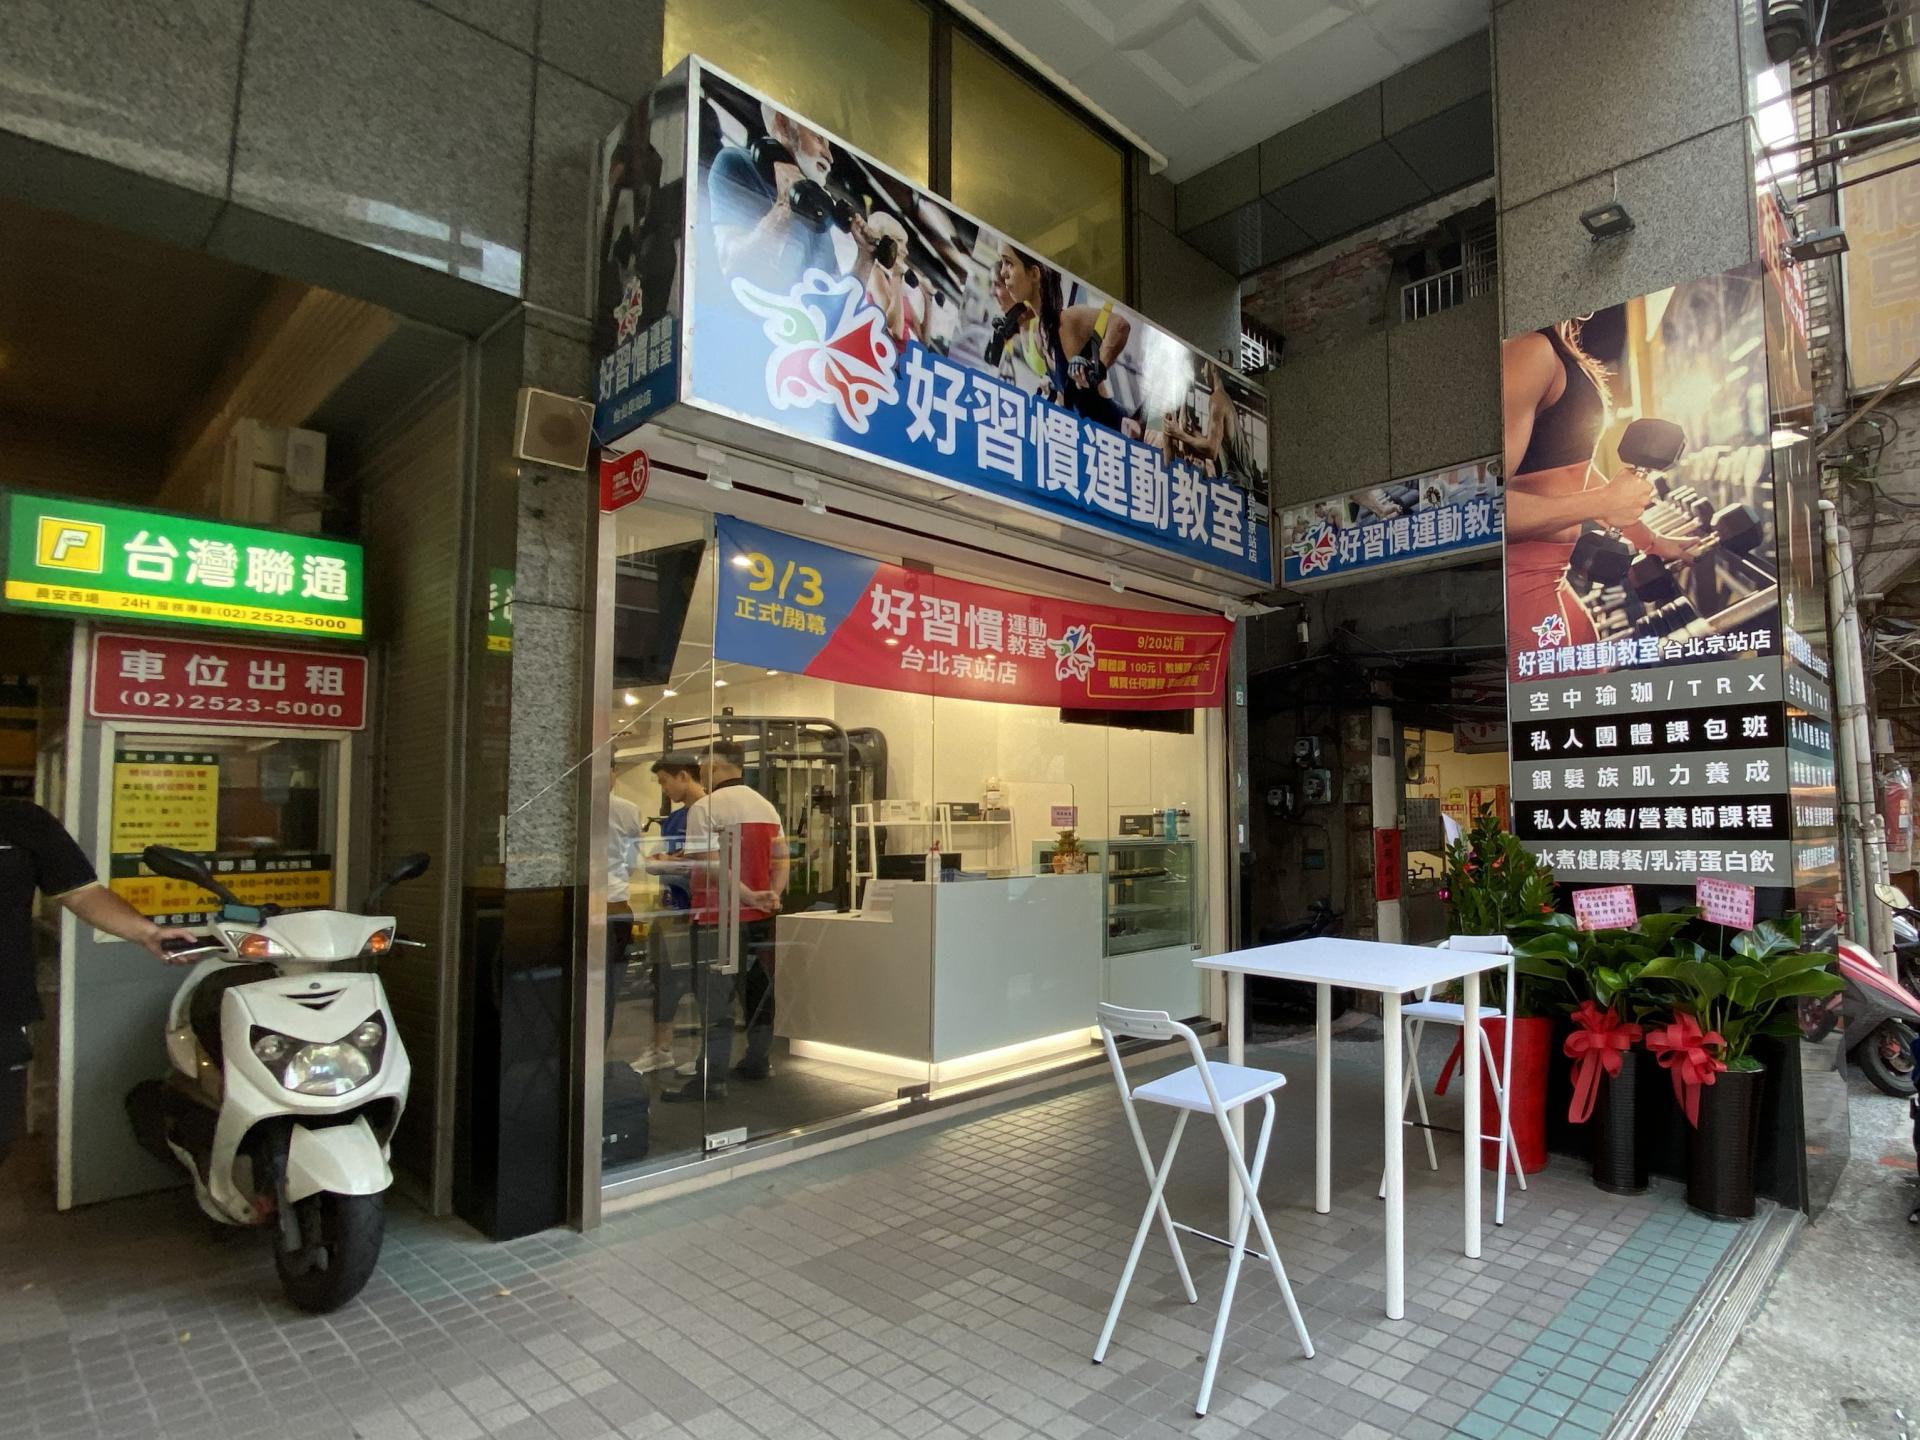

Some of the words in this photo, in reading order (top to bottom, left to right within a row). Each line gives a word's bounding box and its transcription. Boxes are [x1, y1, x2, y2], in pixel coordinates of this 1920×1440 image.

[906, 347, 1245, 557] 好習慣運動教室
[124, 530, 349, 602] 台灣聯通
[749, 552, 825, 607] 9/3
[121, 597, 151, 609] 24H
[251, 611, 347, 630] 2523-5000
[734, 595, 827, 636] 正式開幕
[870, 583, 1004, 653] 好習慣
[1007, 613, 1047, 638] 運動
[900, 645, 1018, 685] 台北京站店
[1007, 633, 1047, 659] 教室
[1518, 636, 1660, 677] 好習慣運動教室
[1663, 629, 1771, 660] 台北京站店
[119, 649, 345, 696] 車位出租
[119, 690, 343, 718] (02)2523-5000
[1531, 715, 1768, 752] 私人團體課包班
[1532, 759, 1770, 790] 銀髮族肌力養成
[1533, 805, 1773, 830] 私人教練/營養師課程
[1536, 849, 1775, 873] 水煮健康餐/乳清蛋白飲
